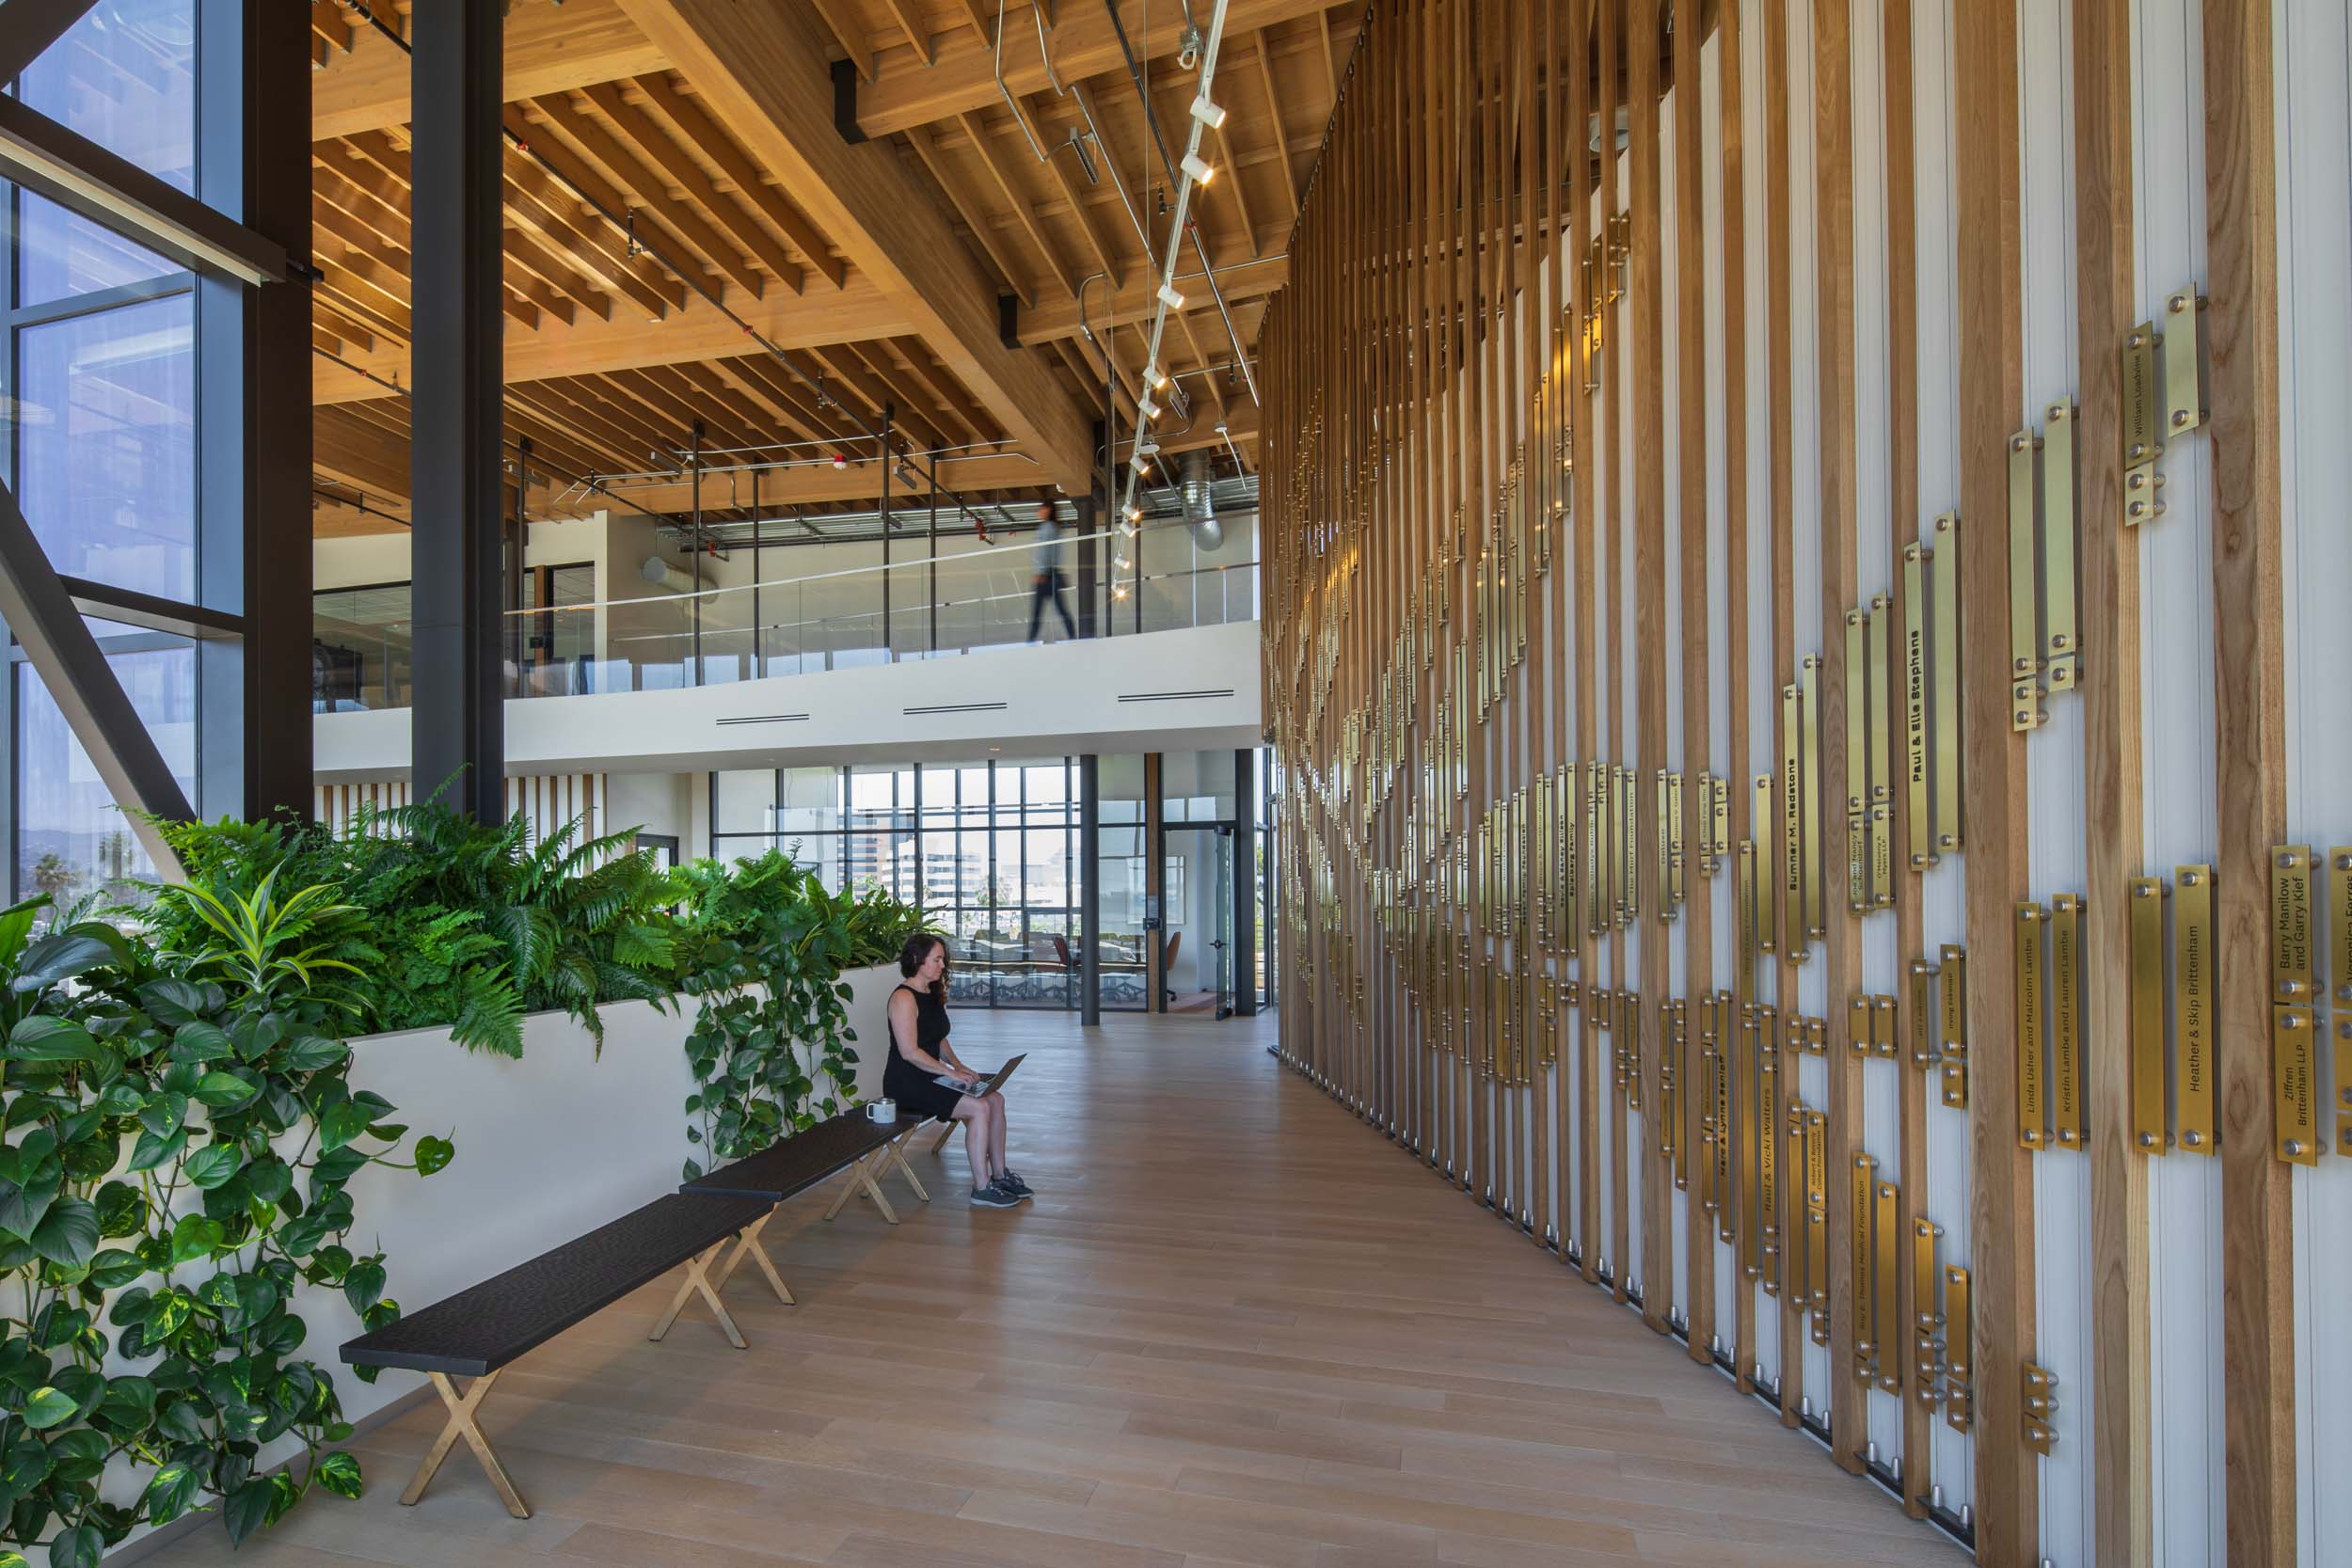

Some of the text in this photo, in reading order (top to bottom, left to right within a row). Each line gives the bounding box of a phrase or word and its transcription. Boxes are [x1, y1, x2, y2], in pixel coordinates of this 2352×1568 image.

[1910, 630, 1922, 700] Stephens
[1912, 736, 1921, 746] &
[1912, 751, 1922, 782] Paul
[1788, 758, 1798, 891] Sumner M. Redstone
[2278, 878, 2292, 969] Barry Manilow
[2292, 877, 2307, 970] and Garry Kief
[2024, 938, 2032, 974] Lambe
[2187, 926, 2199, 995] Brittenham
[2025, 977, 2033, 1023] Malcolm
[2060, 970, 2069, 1008] Lauren
[2188, 999, 2201, 1026] Skip
[2026, 1050, 2034, 1081] Usher
[2189, 1041, 2200, 1092] Heather
[2284, 1067, 2294, 1101] Ziffren
[2026, 1084, 2035, 1114] Linda
[2062, 1076, 2071, 1113] Kristin
[2296, 1044, 2307, 1126] Brittenham LLP
